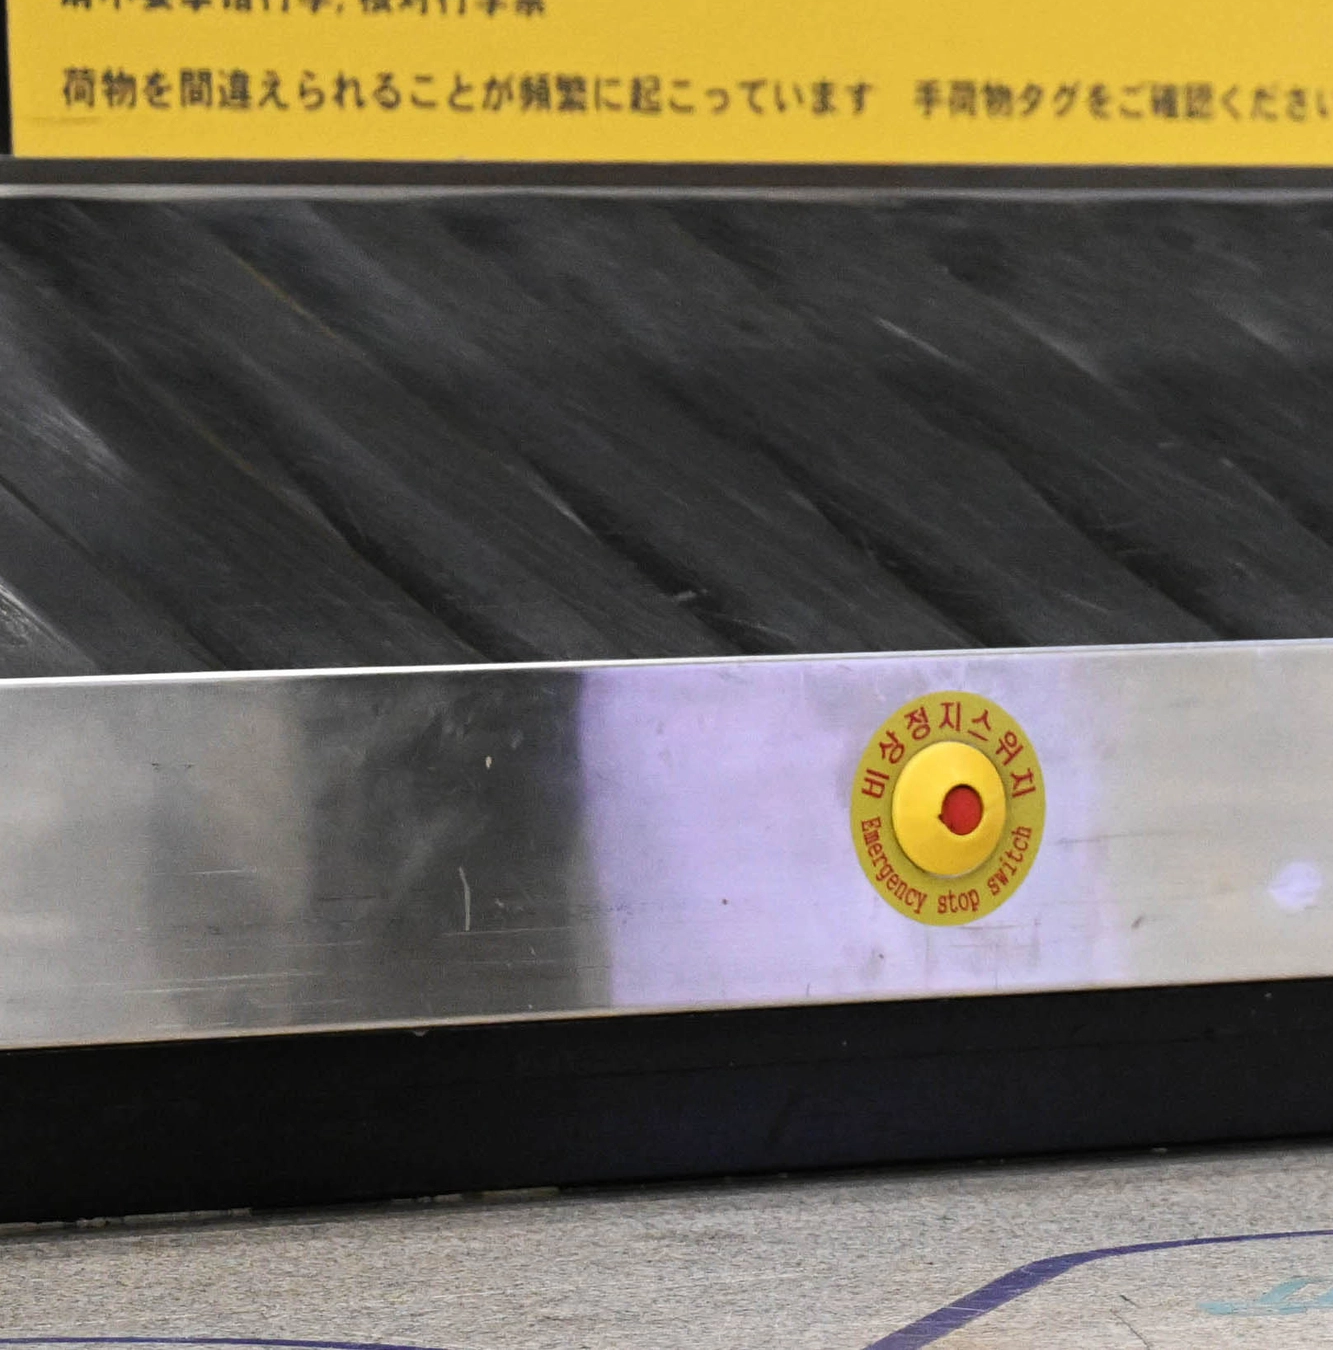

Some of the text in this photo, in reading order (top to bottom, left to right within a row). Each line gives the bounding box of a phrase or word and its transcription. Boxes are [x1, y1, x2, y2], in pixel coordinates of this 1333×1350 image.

[861, 816, 1032, 915] Emergency stop switch
